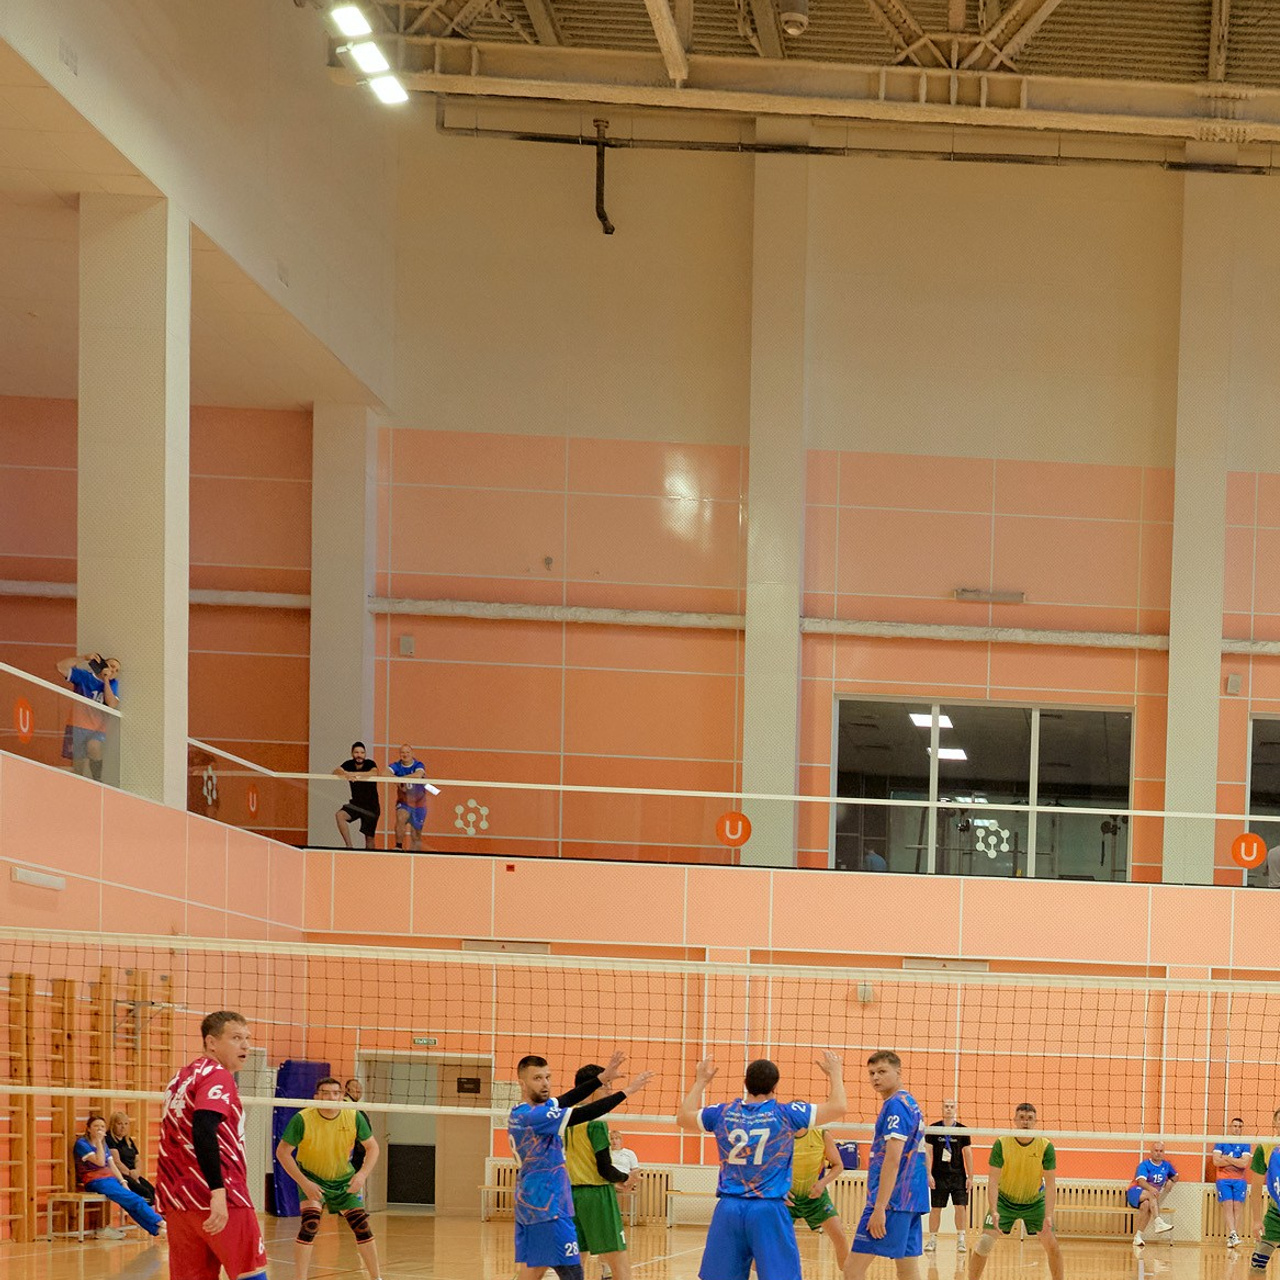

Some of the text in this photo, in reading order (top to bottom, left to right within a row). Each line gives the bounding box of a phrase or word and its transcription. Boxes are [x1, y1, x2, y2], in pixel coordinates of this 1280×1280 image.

[725, 820, 743, 839] U
[1240, 842, 1257, 861] U
[887, 1115, 900, 1129] 22
[728, 1128, 771, 1166] 27
[1153, 1173, 1163, 1183] 15
[564, 1241, 580, 1257] 28
